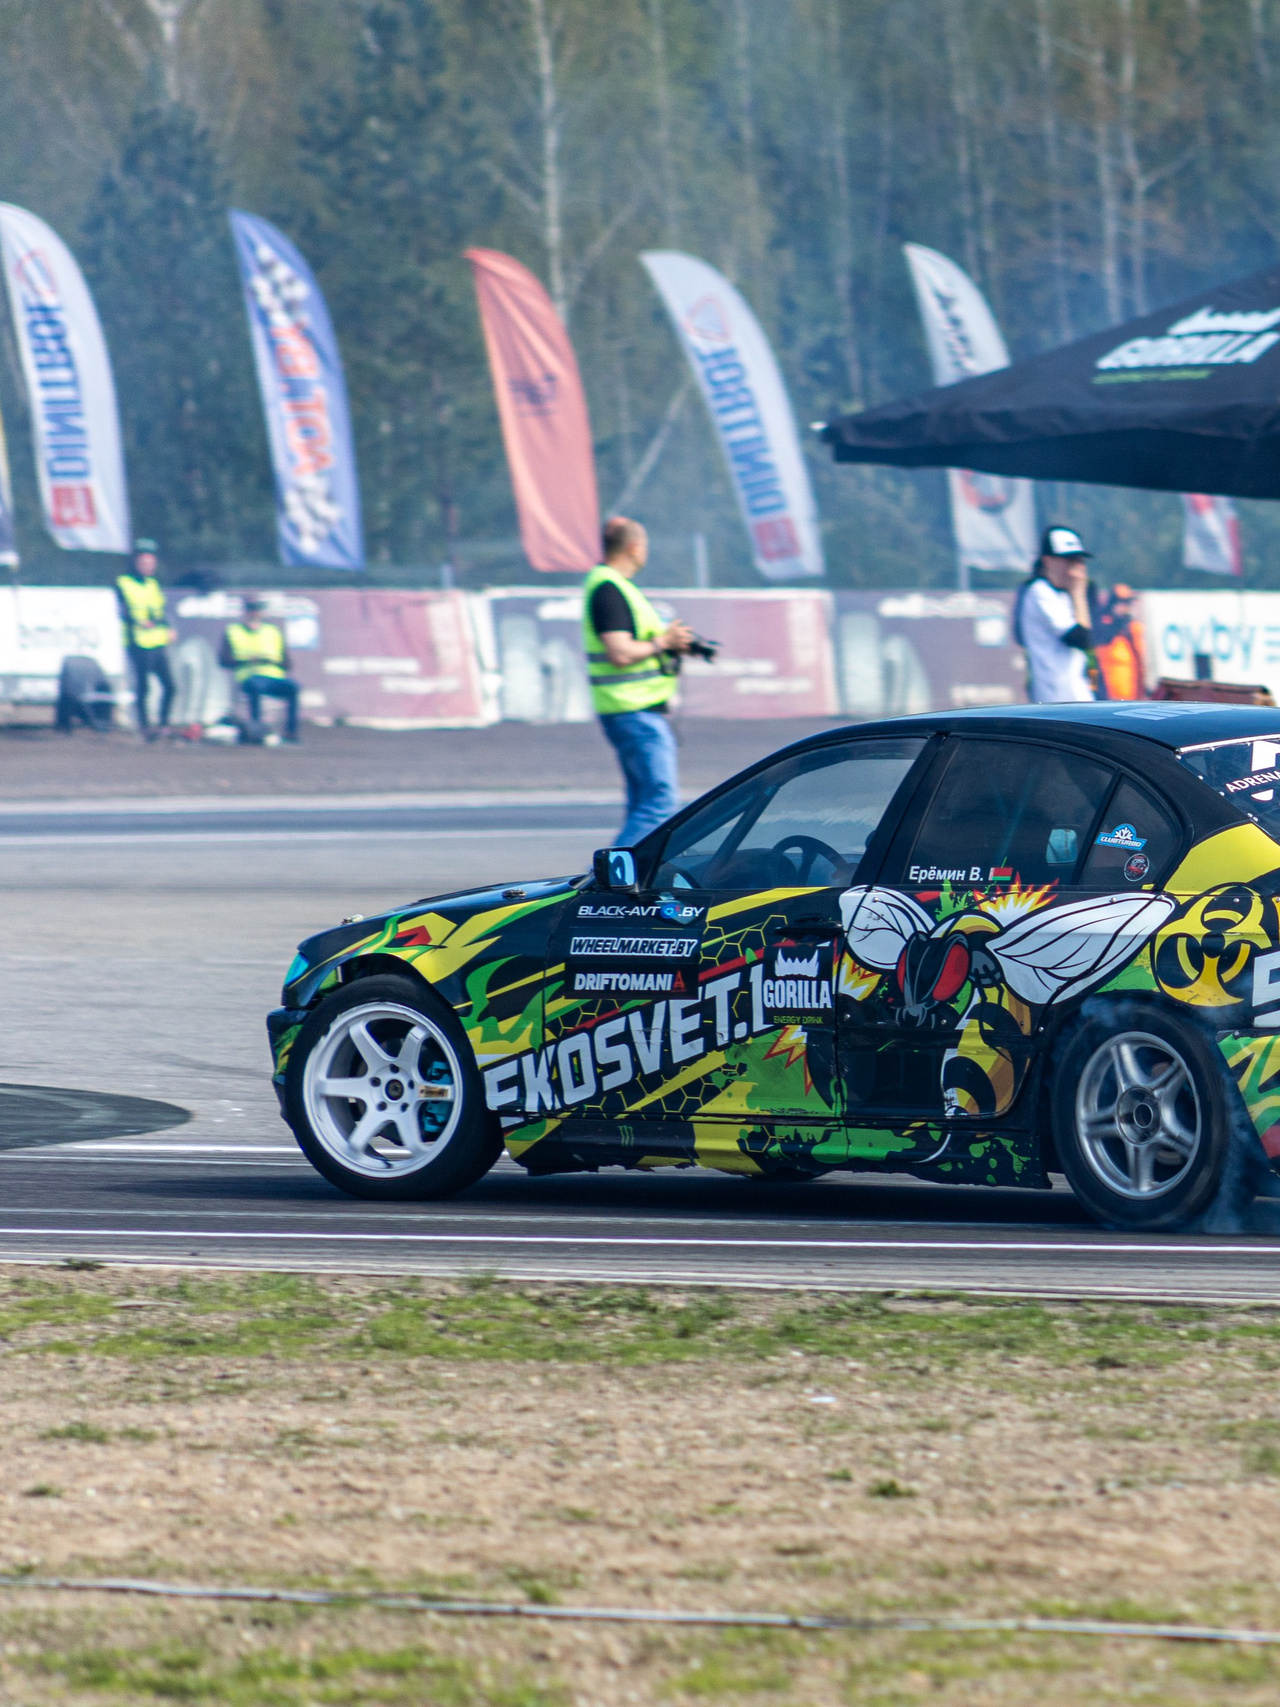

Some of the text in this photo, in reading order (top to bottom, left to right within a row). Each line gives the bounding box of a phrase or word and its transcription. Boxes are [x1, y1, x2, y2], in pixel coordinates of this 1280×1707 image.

[909, 865, 984, 884] Ерёмин В.
[571, 937, 698, 957] WHEELMARKET.BY
[574, 969, 687, 993] DRIFTOMANIA
[763, 979, 832, 1009] GORILLA
[773, 1015, 823, 1024] ENERGY DRINK
